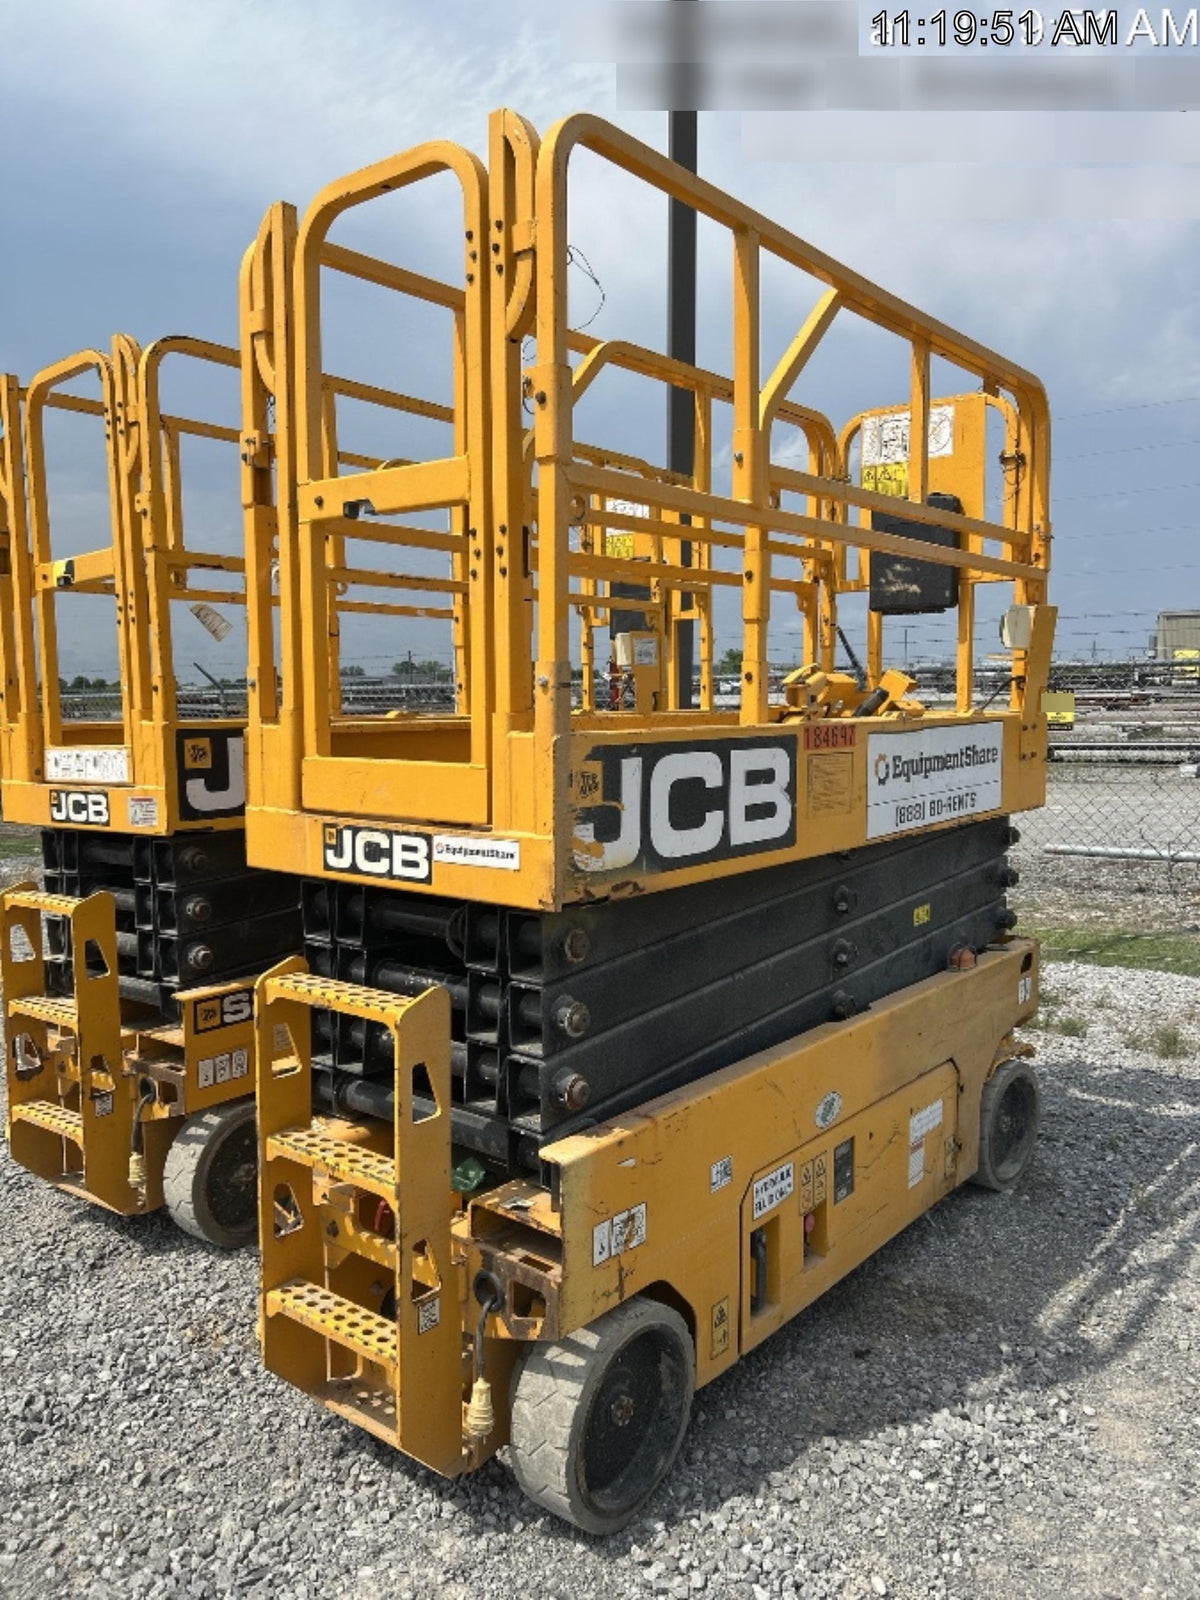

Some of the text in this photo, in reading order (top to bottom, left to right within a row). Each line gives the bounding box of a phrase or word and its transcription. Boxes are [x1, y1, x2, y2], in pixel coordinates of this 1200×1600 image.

[892, 744, 998, 782] EquipmentShare
[51, 791, 109, 823] JCB
[572, 747, 791, 871] JCB
[325, 829, 429, 879] JCB
